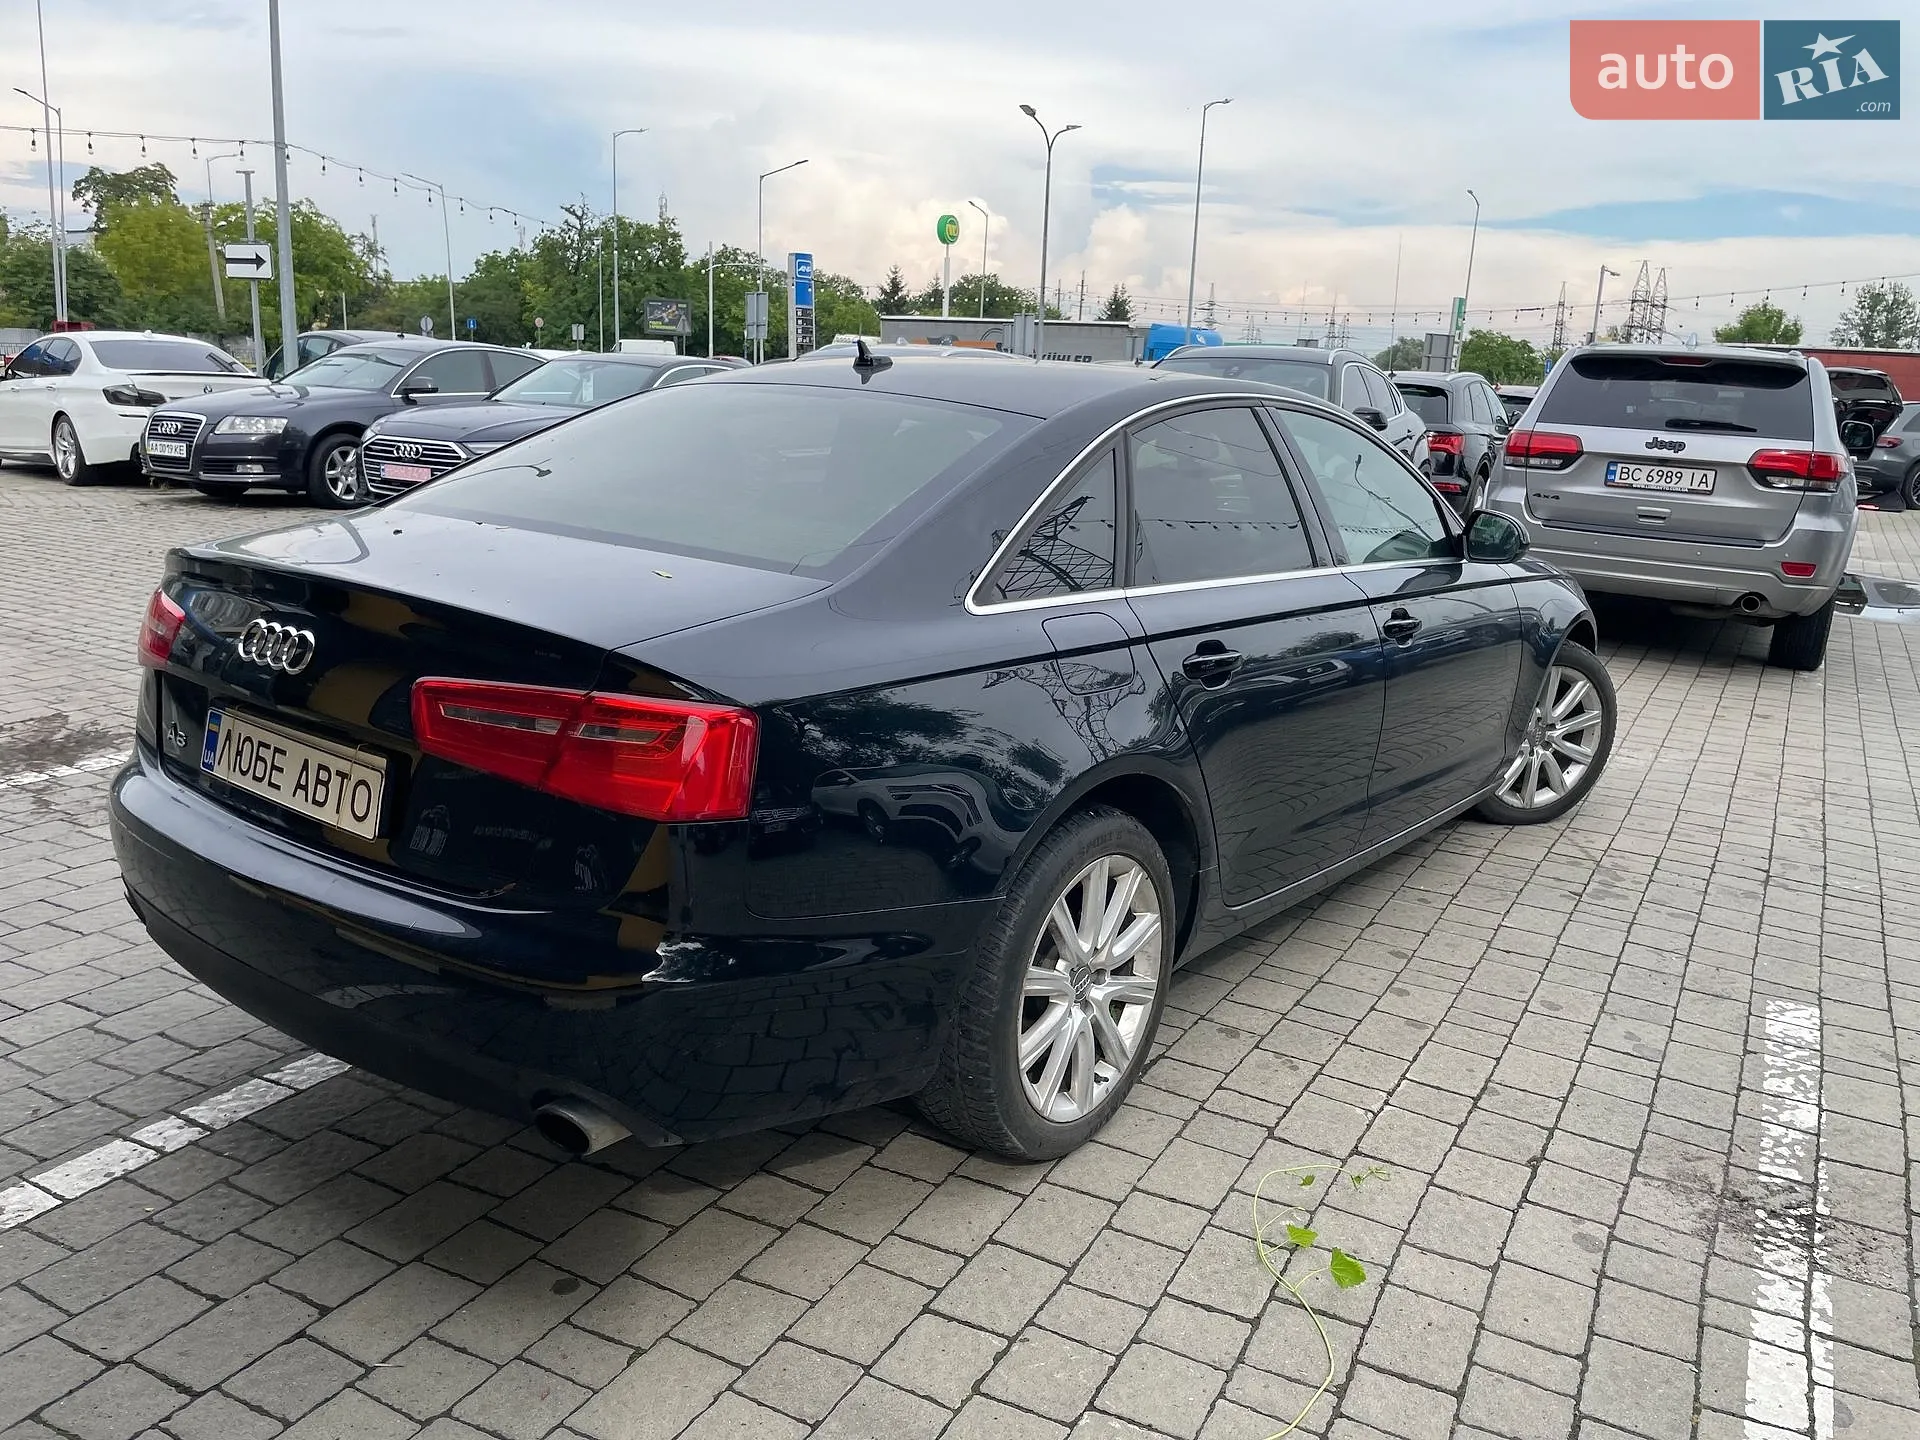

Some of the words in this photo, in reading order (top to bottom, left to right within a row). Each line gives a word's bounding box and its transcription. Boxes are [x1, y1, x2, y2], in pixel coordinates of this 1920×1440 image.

[1645, 437, 1686, 453] Jeep
[1620, 466, 1642, 481] BC
[1646, 468, 1683, 485] 6989
[1690, 472, 1709, 488] IA
[167, 722, 187, 748] A6
[217, 728, 287, 791] ЛЮБЕ
[292, 758, 372, 822] АВТО
